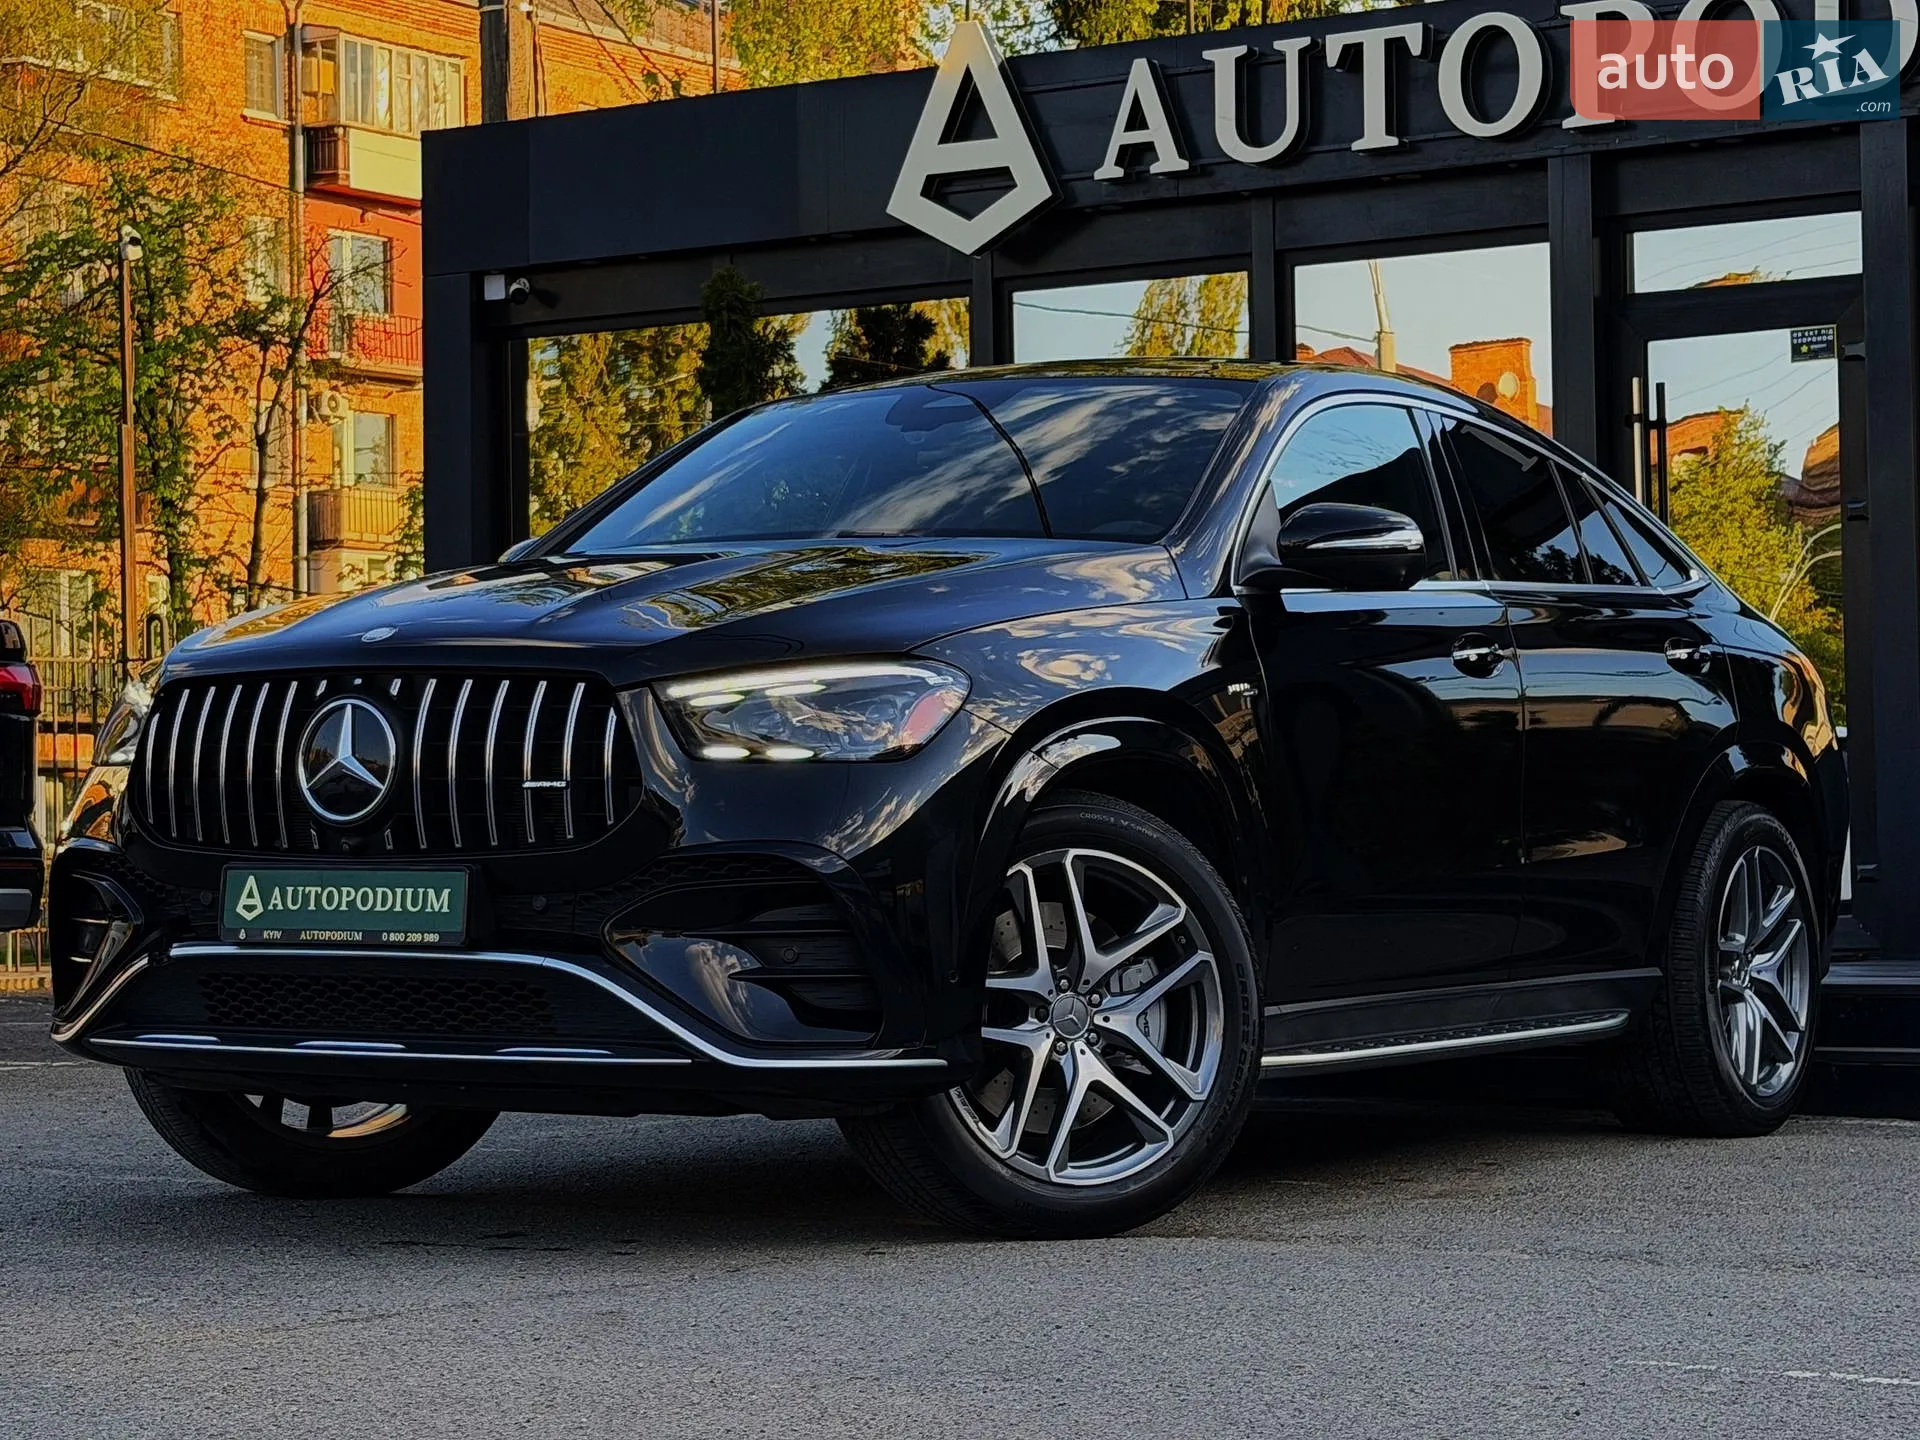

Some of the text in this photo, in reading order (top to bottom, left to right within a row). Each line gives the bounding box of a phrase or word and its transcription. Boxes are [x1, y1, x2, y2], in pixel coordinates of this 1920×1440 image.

[268, 886, 452, 913] AUTOPODIUM
[263, 930, 282, 940] KYIV
[300, 930, 363, 942] AUTOPODIUM
[389, 933, 405, 942] 800
[406, 933, 422, 943] 209
[423, 933, 440, 943] 989
